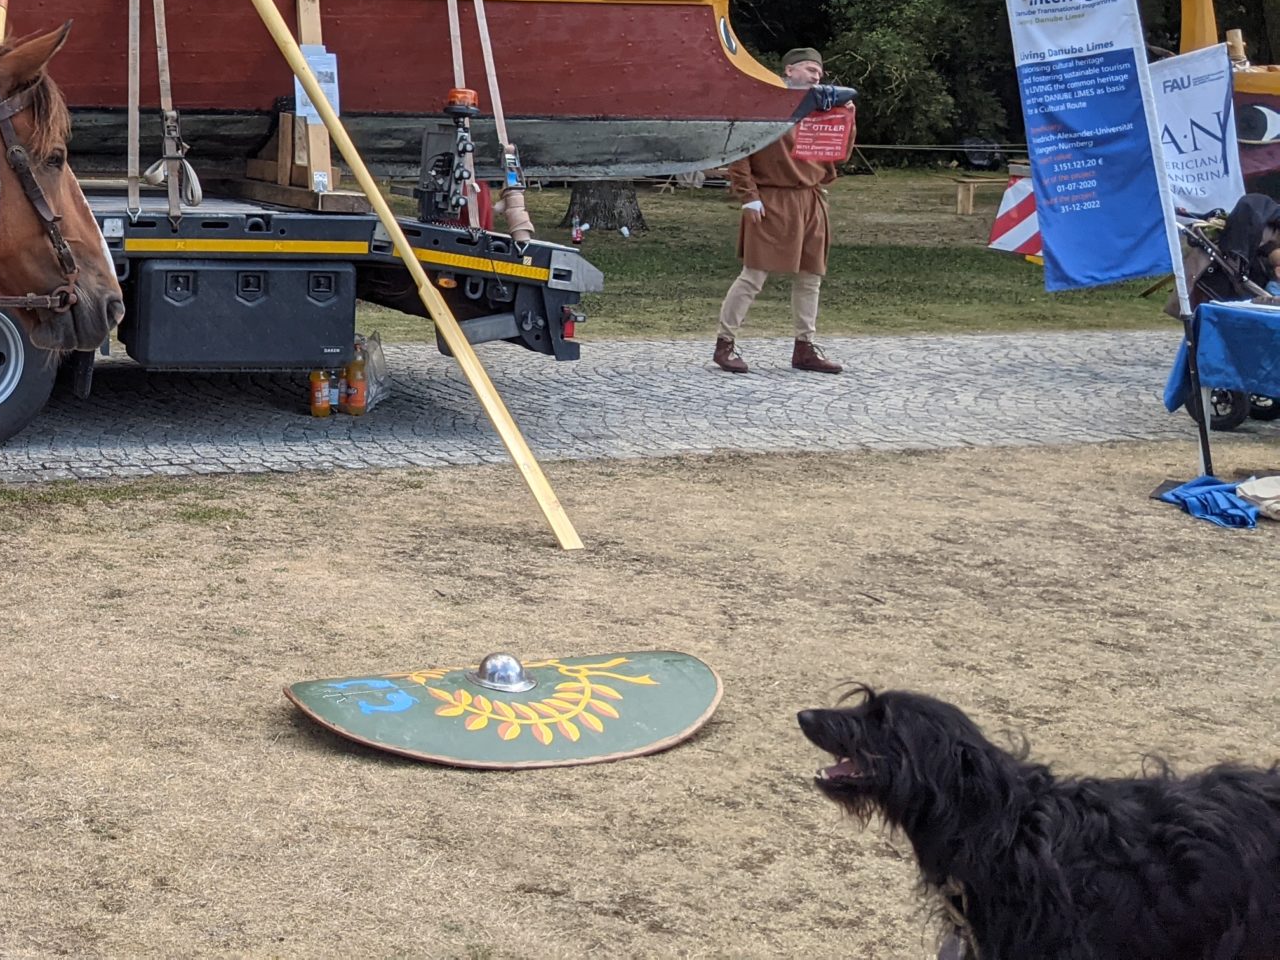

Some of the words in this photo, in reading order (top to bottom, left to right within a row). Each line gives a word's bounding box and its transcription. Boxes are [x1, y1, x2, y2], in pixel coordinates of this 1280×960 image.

[1038, 5, 1080, 14] Transnational
[1048, 44, 1084, 57] Danube
[1086, 40, 1114, 52] Limes
[1075, 56, 1104, 67] heritage
[1032, 73, 1063, 84] fostering
[1064, 68, 1100, 79] sustainable
[1101, 62, 1131, 73] tourism
[1030, 84, 1053, 94] LIVING
[1053, 82, 1065, 91] the
[1067, 79, 1096, 89] common
[1097, 73, 1129, 84] heritage
[1162, 74, 1191, 94] FAU
[1044, 92, 1072, 102] DANUBE
[1074, 89, 1095, 99] LIMES
[1106, 83, 1126, 94] basis
[1039, 103, 1065, 114] Cultural
[1066, 101, 1087, 111] Route
[1053, 158, 1097, 173] 3.151.121,20
[1098, 157, 1103, 166] €
[1056, 179, 1097, 193] 01-07-2020
[1061, 200, 1101, 214] 31-12-2022
